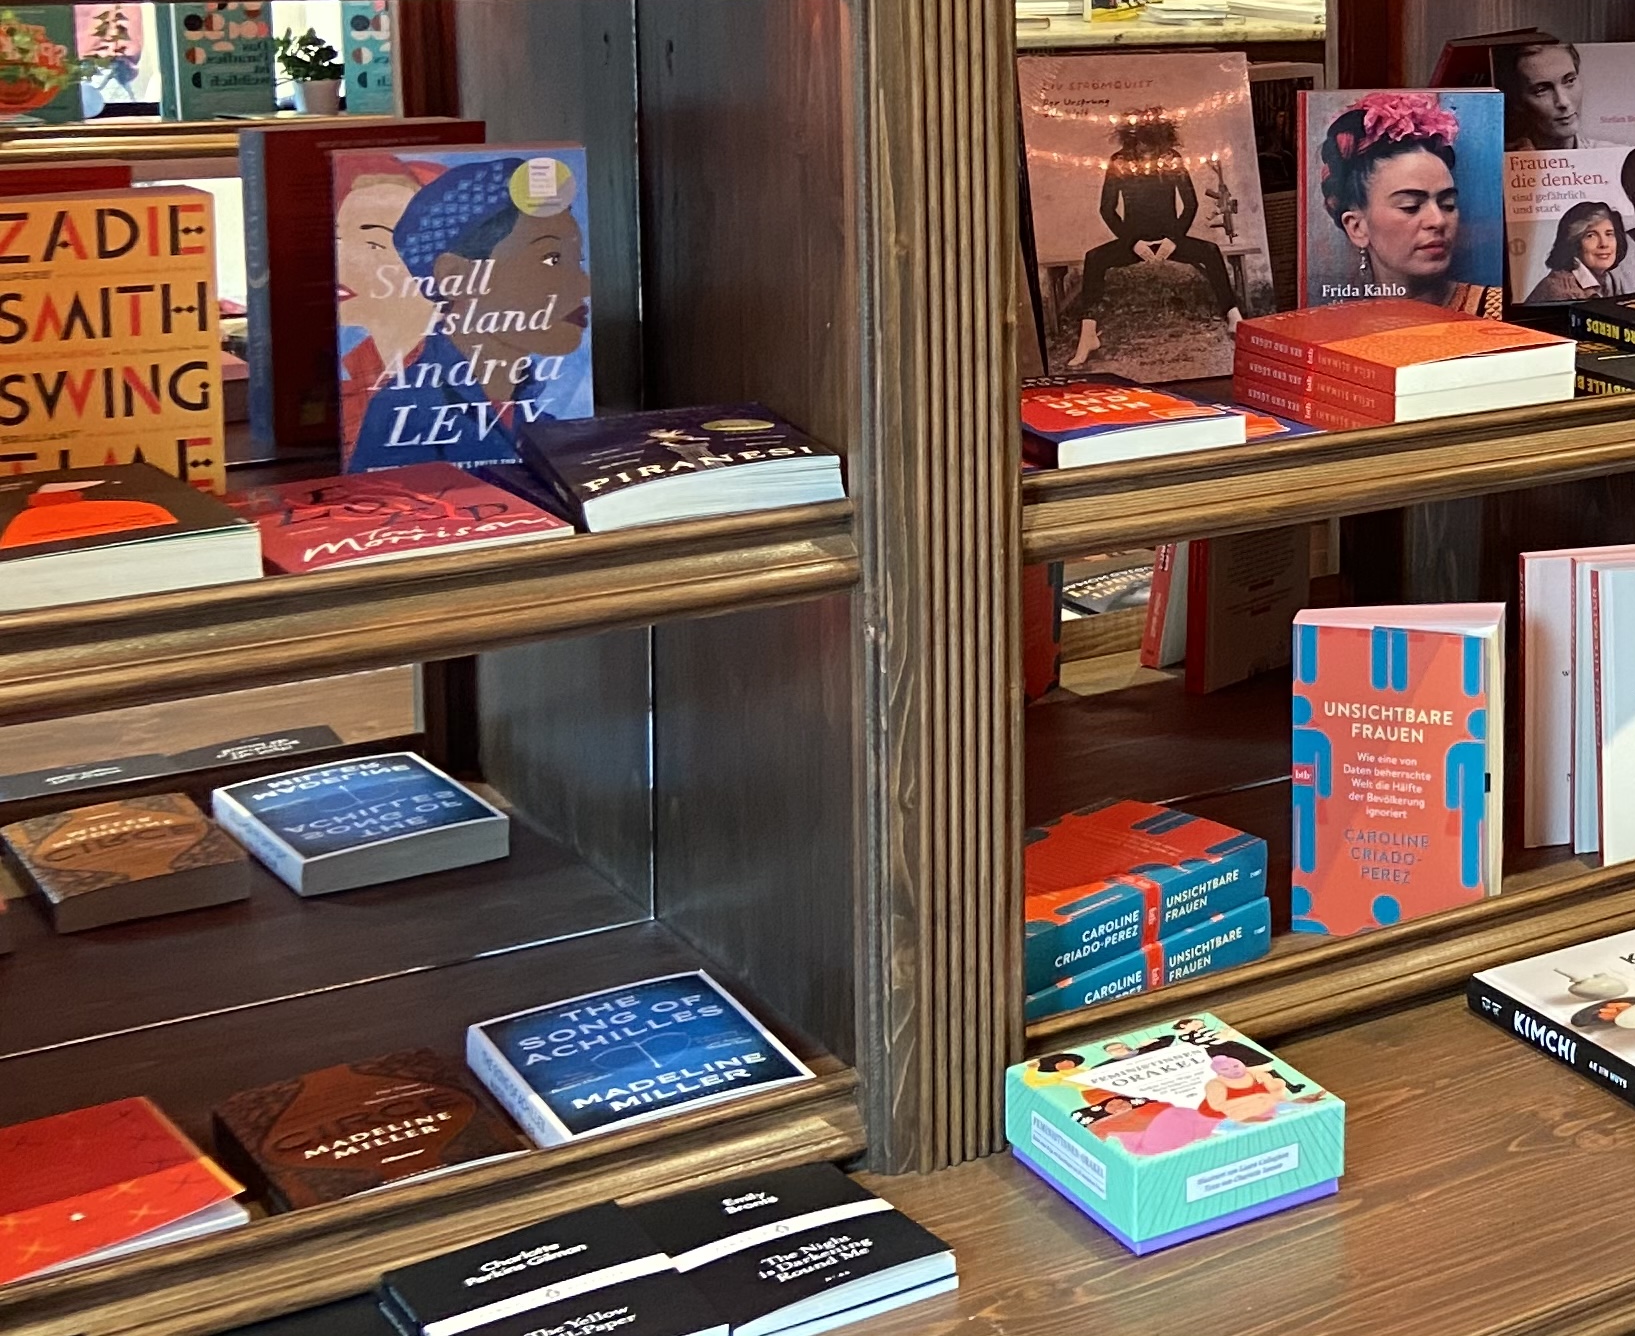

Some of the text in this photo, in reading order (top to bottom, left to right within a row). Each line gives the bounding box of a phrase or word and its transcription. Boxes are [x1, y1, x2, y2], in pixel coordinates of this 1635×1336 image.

[1509, 155, 1576, 172] Frauen,
[1510, 170, 1609, 188] die denken,
[0, 205, 206, 263] ZADIE
[370, 259, 495, 300] Small
[1322, 283, 1407, 297] Frida Kahlo
[0, 281, 208, 344] SMITH
[424, 296, 557, 337] Island
[1585, 317, 1620, 339] NERDS
[367, 353, 566, 392] Andrea
[0, 361, 209, 426] SWING
[1048, 394, 1129, 409] UND
[1065, 400, 1151, 417] SEIN
[383, 396, 555, 448] LEVY
[582, 445, 813, 492] PIRANESI
[304, 517, 549, 562] Morrison
[1324, 701, 1454, 726] UNSICHTBARE
[1351, 722, 1424, 744] FRAUEN
[1344, 828, 1430, 850] CAROLINE
[1351, 847, 1423, 866] CRIADO-
[1166, 868, 1240, 908] UNSICHTBARE
[1360, 866, 1411, 885] PEREZ
[1082, 909, 1140, 943] CAROLINE
[1165, 894, 1208, 923] FRAUEN
[1054, 924, 1139, 969] CRIADO-PEREZ
[517, 994, 702, 1051] SONG OF
[559, 994, 641, 1023] THE
[525, 1004, 724, 1066] ACHILLES
[1512, 1009, 1578, 1065] KIMCHI
[571, 1052, 768, 1110] MADELINE
[1111, 1057, 1206, 1087] ORAKEL
[609, 1068, 753, 1112] MILLER
[304, 1111, 453, 1160] MADELINE
[334, 1125, 441, 1160] MILLER
[478, 1242, 560, 1272] Charlotte
[526, 1243, 588, 1267] Gilman
[759, 1235, 852, 1266] The Night
[775, 1237, 874, 1273] Darkening
[776, 1246, 871, 1283] Round Me
[573, 1306, 629, 1331] Yellow
